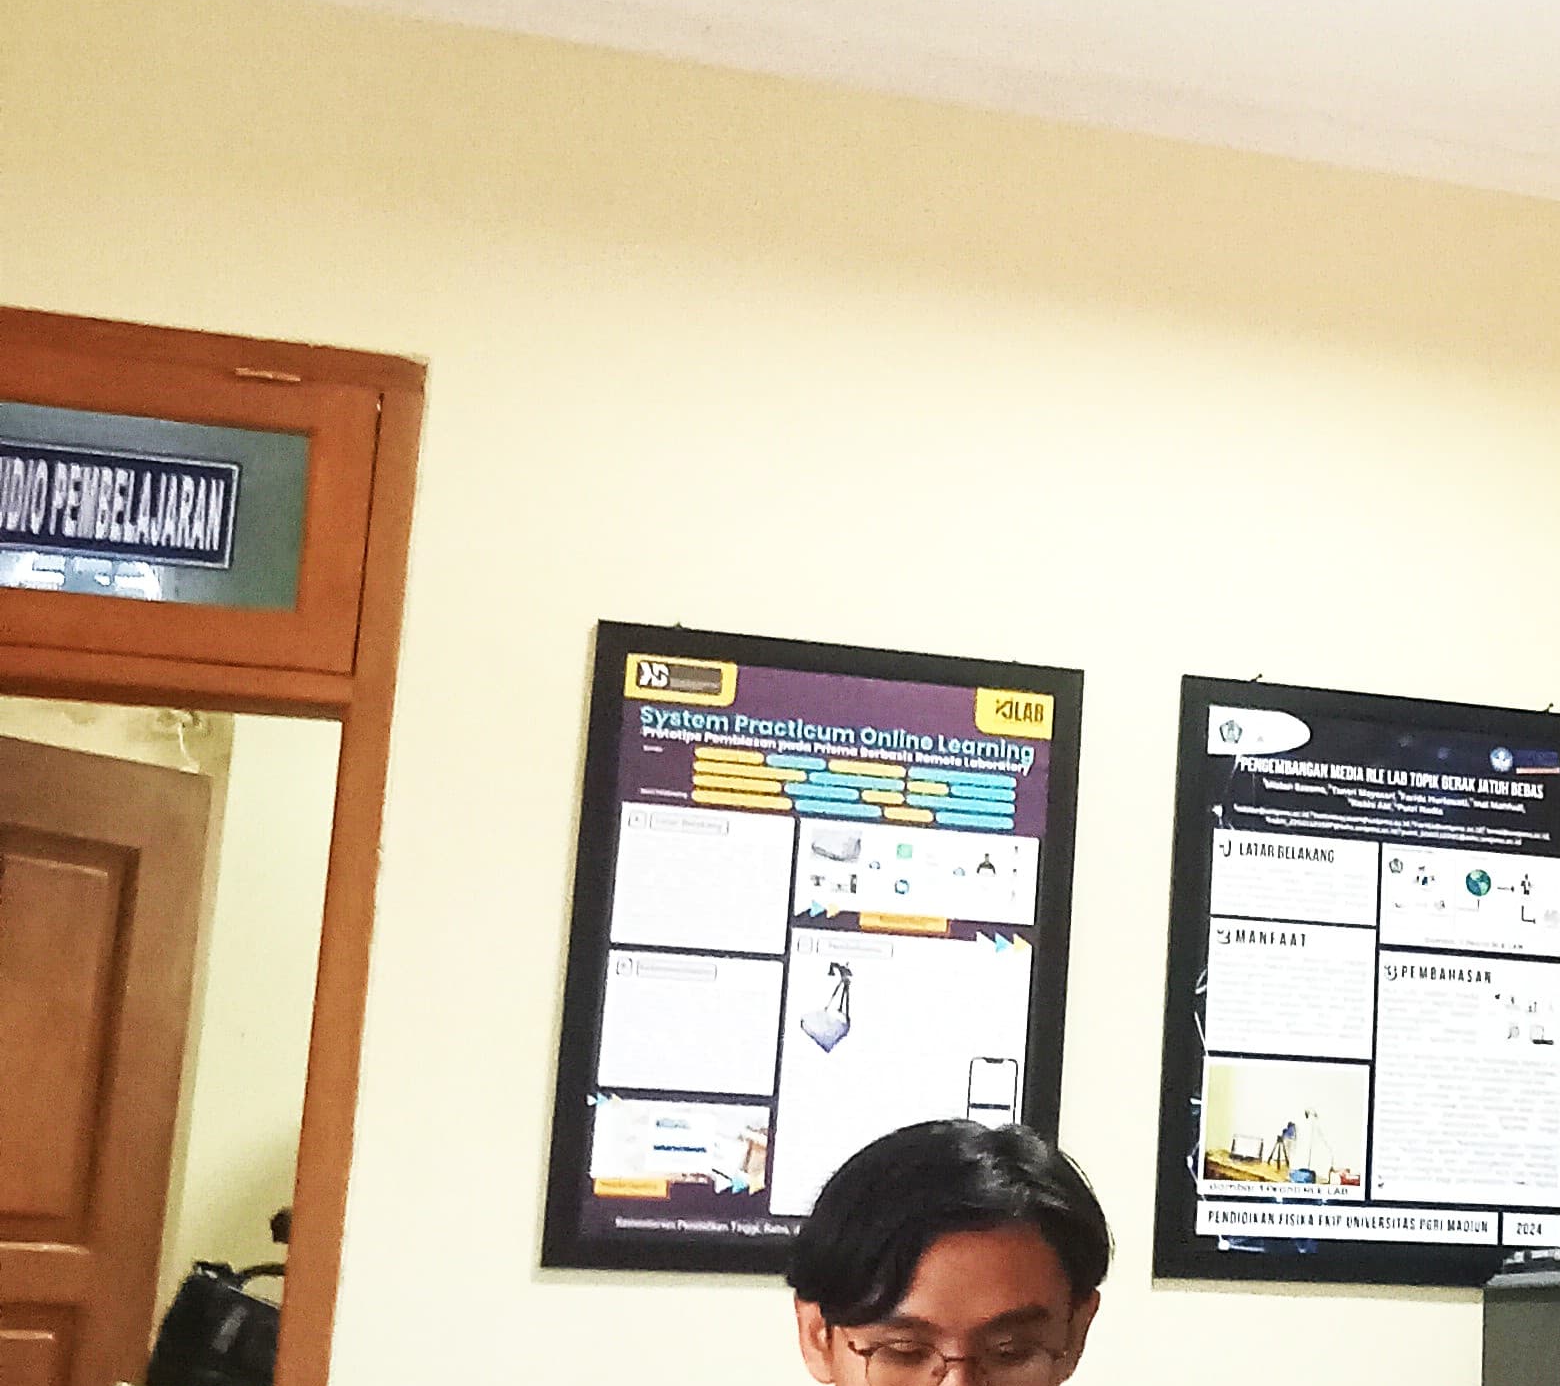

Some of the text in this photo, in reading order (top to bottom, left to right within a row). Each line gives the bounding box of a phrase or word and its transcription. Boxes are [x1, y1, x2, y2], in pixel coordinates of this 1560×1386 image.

[50, 460, 225, 551] PEMBELAJARAN
[640, 705, 1035, 764] System Practicum Online Learning
[642, 727, 703, 743] Prototipe
[813, 742, 858, 757] Prisma
[915, 753, 963, 767] Remote
[964, 756, 1032, 776] Laboratory
[1241, 756, 1329, 779] PENGEMBANGAN
[1330, 763, 1364, 782] MEDIA
[1387, 769, 1408, 787] LAB
[1409, 771, 1440, 790] TOPIK
[1441, 774, 1476, 793] GERAK
[1477, 777, 1509, 796] JATUH
[1510, 781, 1545, 800] BEBAS
[1239, 842, 1335, 863] LATAR BELAKANG
[1235, 929, 1306, 947] MANFAAT
[1401, 965, 1492, 984] PEMBAHASAN
[1208, 1210, 1275, 1225] PENDIDIKAN
[1346, 1216, 1415, 1231] UNIVERSITAS
[1516, 1222, 1542, 1236] 2024
